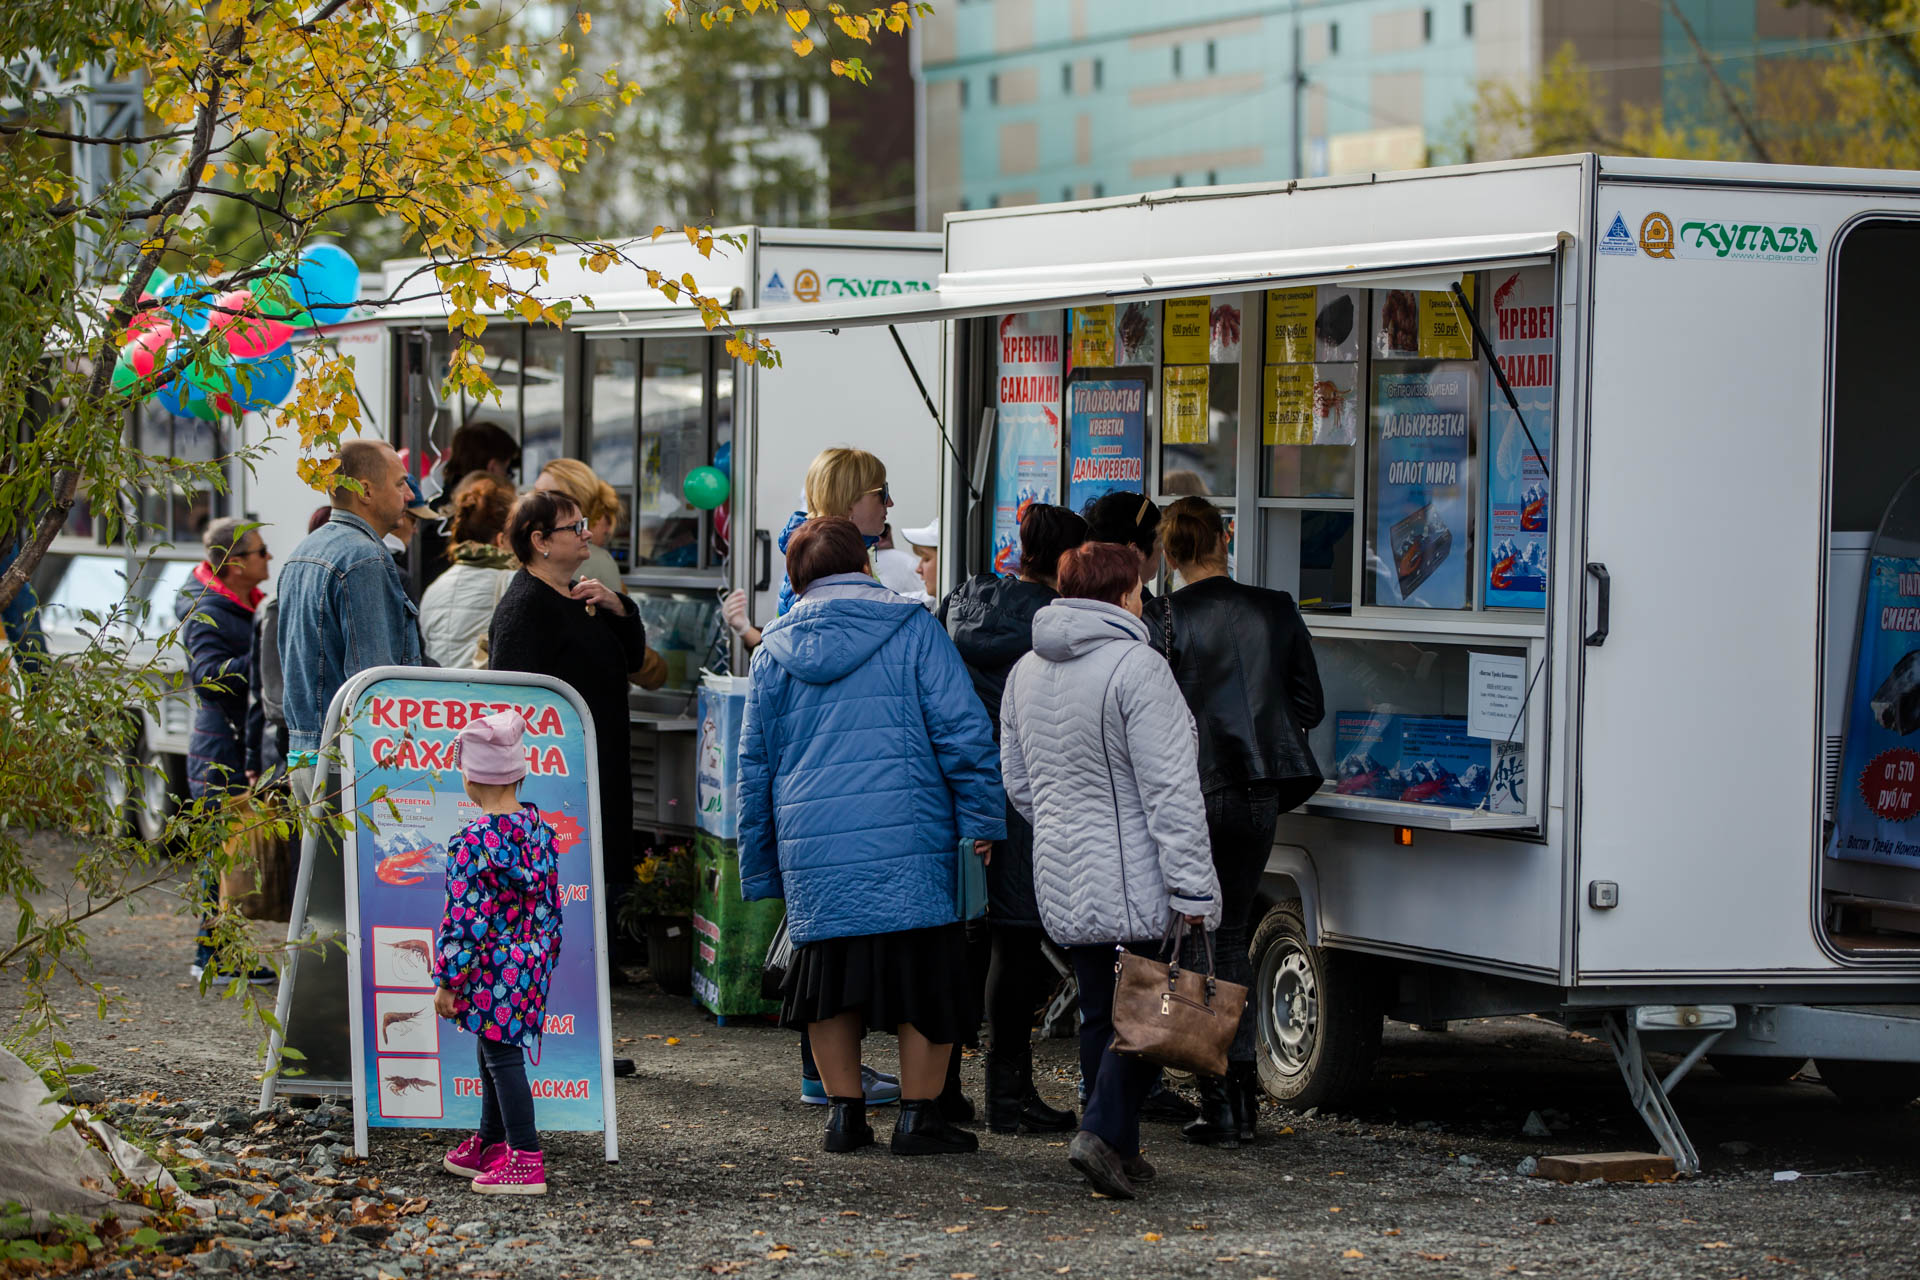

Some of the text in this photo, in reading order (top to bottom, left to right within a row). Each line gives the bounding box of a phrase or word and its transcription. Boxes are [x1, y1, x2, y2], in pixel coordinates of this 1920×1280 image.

[1681, 222, 1818, 257] КУПАВА
[1730, 252, 1818, 261] www.kupava.com
[1434, 322, 1459, 335] 550 руб
[1003, 335, 1059, 363] КРЕВЕТКА
[1000, 376, 1059, 403] САХАЛИНА
[1397, 382, 1459, 398] ПРОИЗВОДИТЕЛЕЙ
[1074, 389, 1140, 414] УГЛОХВОСТАЯ
[1089, 419, 1124, 436] КРЕВЕТКА
[1382, 413, 1465, 439] ДАЛЬКРЕВЕТКА
[1072, 457, 1142, 483] ДАЛЬКРЕВЕТКА
[1389, 461, 1457, 484] ОПЛОТ МИРА
[372, 738, 568, 775] САХАНА
[1884, 761, 1915, 781] от 570
[1878, 788, 1912, 811] руб/кг
[1847, 835, 1870, 851] Восток
[1872, 837, 1894, 856] Трейд
